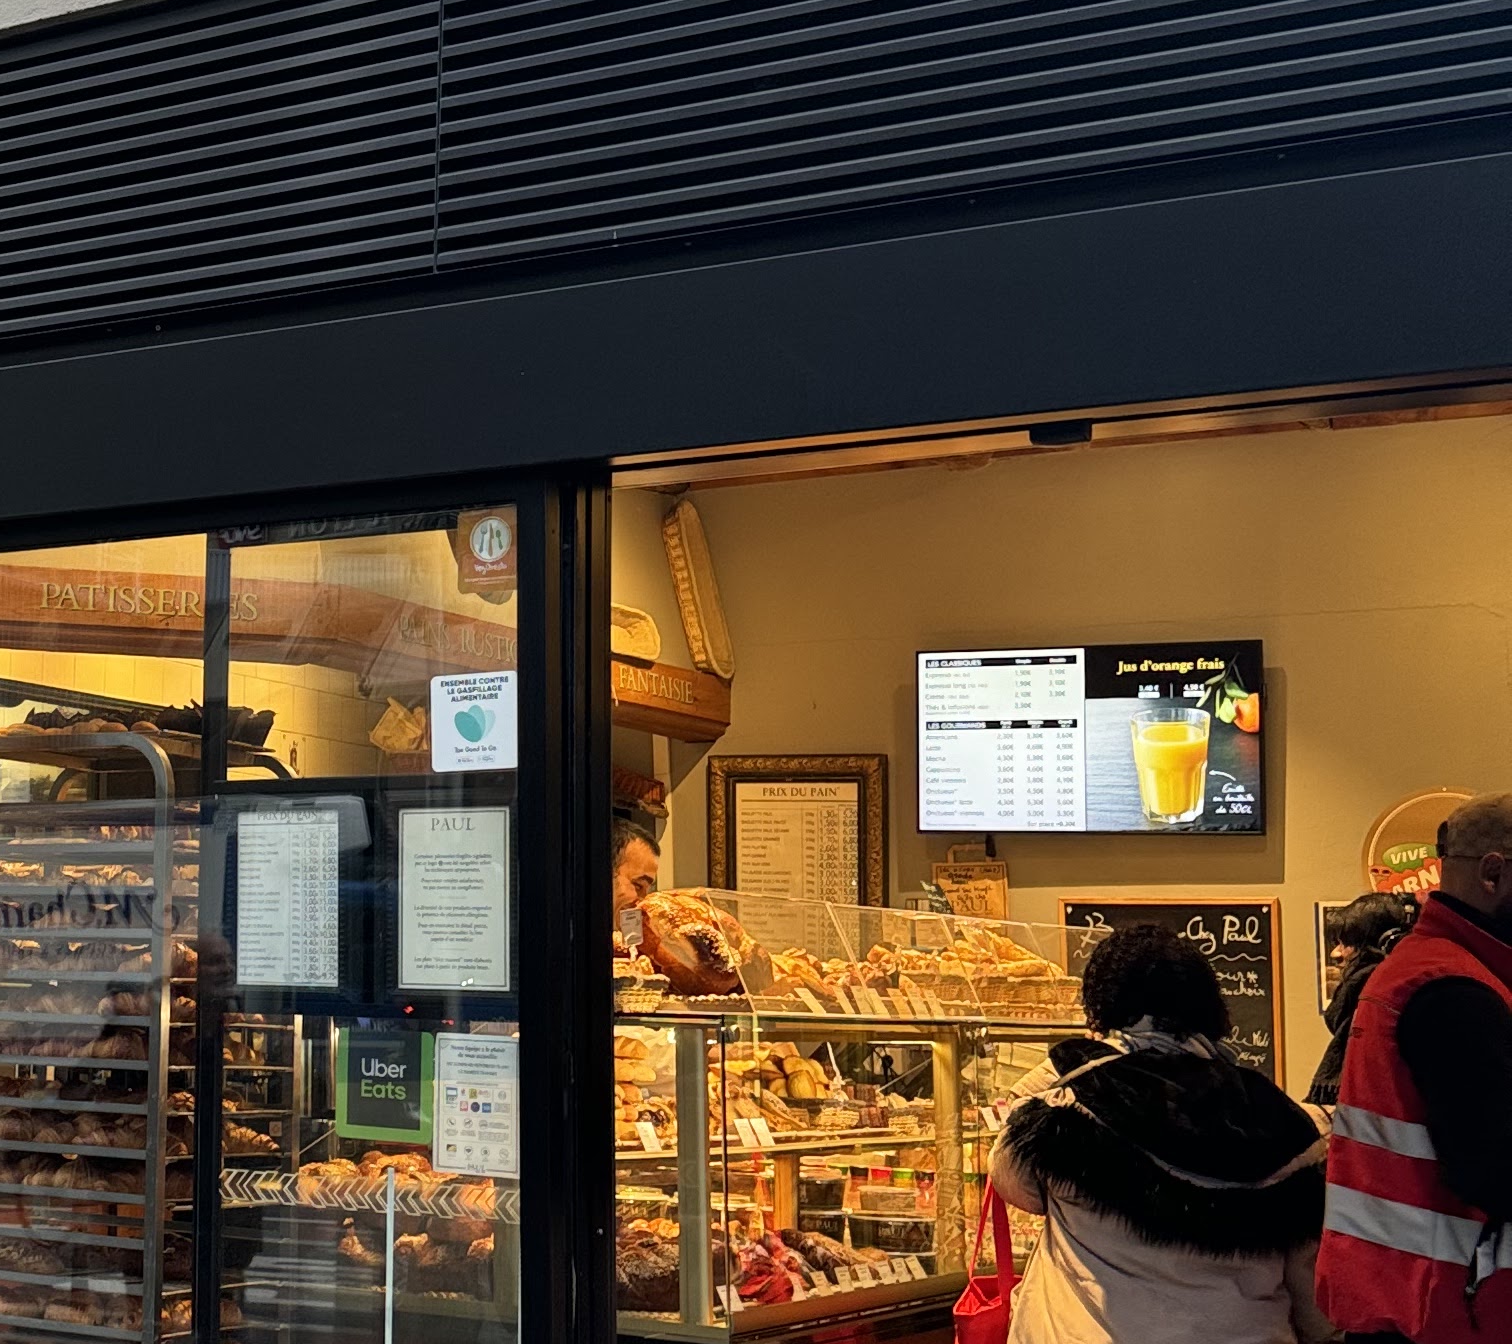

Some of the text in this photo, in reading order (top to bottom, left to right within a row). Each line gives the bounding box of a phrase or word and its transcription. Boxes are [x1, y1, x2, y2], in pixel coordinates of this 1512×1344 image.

[40, 581, 259, 622] PATISSERES
[399, 613, 450, 650] PAINS
[940, 659, 982, 667] CLASSIQUES
[1116, 660, 1138, 675] Jus
[1196, 658, 1225, 670] frais
[440, 676, 509, 687] ENSEMBLE CONTRE
[457, 684, 502, 694] GASPILLAGE
[619, 665, 694, 704] FANTAISIE
[451, 693, 498, 702] ALIMENTAIRE
[762, 787, 787, 797] PRIX
[791, 787, 807, 797] DU
[431, 817, 476, 831] PAUL
[1390, 846, 1428, 865] VIVE
[1187, 915, 1262, 955] Chez Paul
[361, 1057, 407, 1078] Uber
[360, 1078, 406, 1100] Eats
